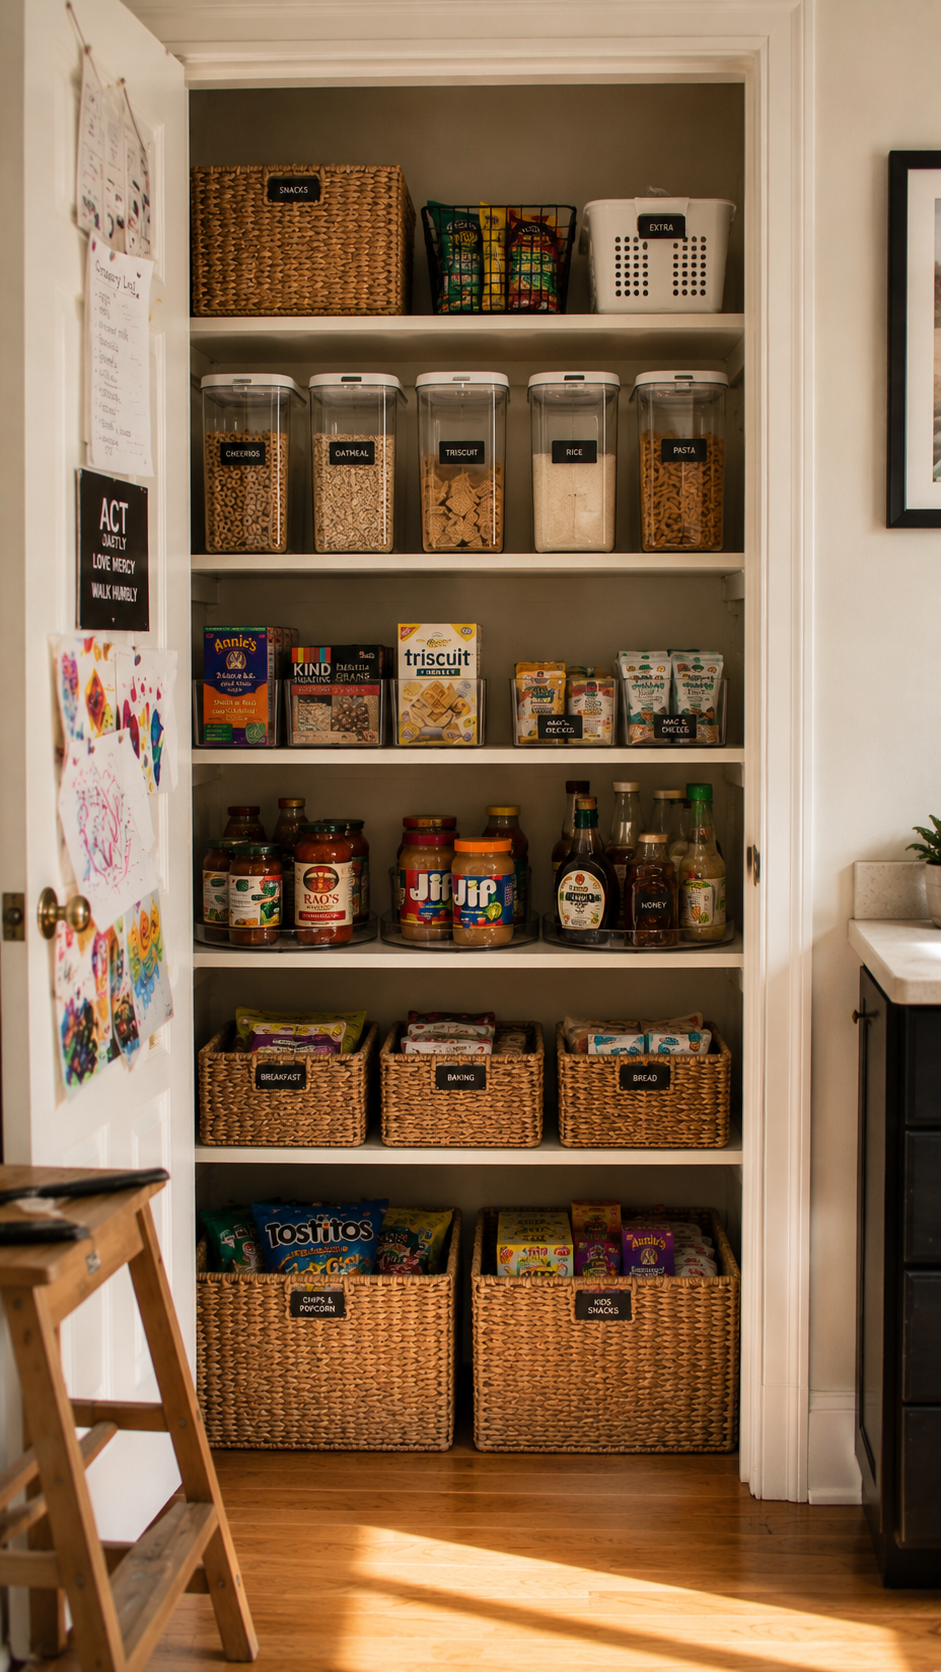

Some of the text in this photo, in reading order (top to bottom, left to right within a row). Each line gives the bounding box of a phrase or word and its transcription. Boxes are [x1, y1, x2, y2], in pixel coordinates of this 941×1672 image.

[279, 186, 308, 194] SNACKS
[649, 223, 674, 232] EXTRA
[335, 449, 369, 457] OATMEAL
[445, 449, 478, 457] TRISCUIT
[566, 448, 583, 456] RICE
[673, 446, 696, 454] PASTA
[99, 497, 129, 535] ACT
[92, 552, 136, 575] LOVE MERCY
[91, 582, 111, 600] WALK
[214, 634, 257, 653] Annie's
[293, 663, 332, 677] KIND
[641, 901, 667, 909] HONEY
[447, 1073, 475, 1082] BAKING
[633, 1074, 657, 1082] BREAD
[593, 1299, 611, 1307] KIDS
